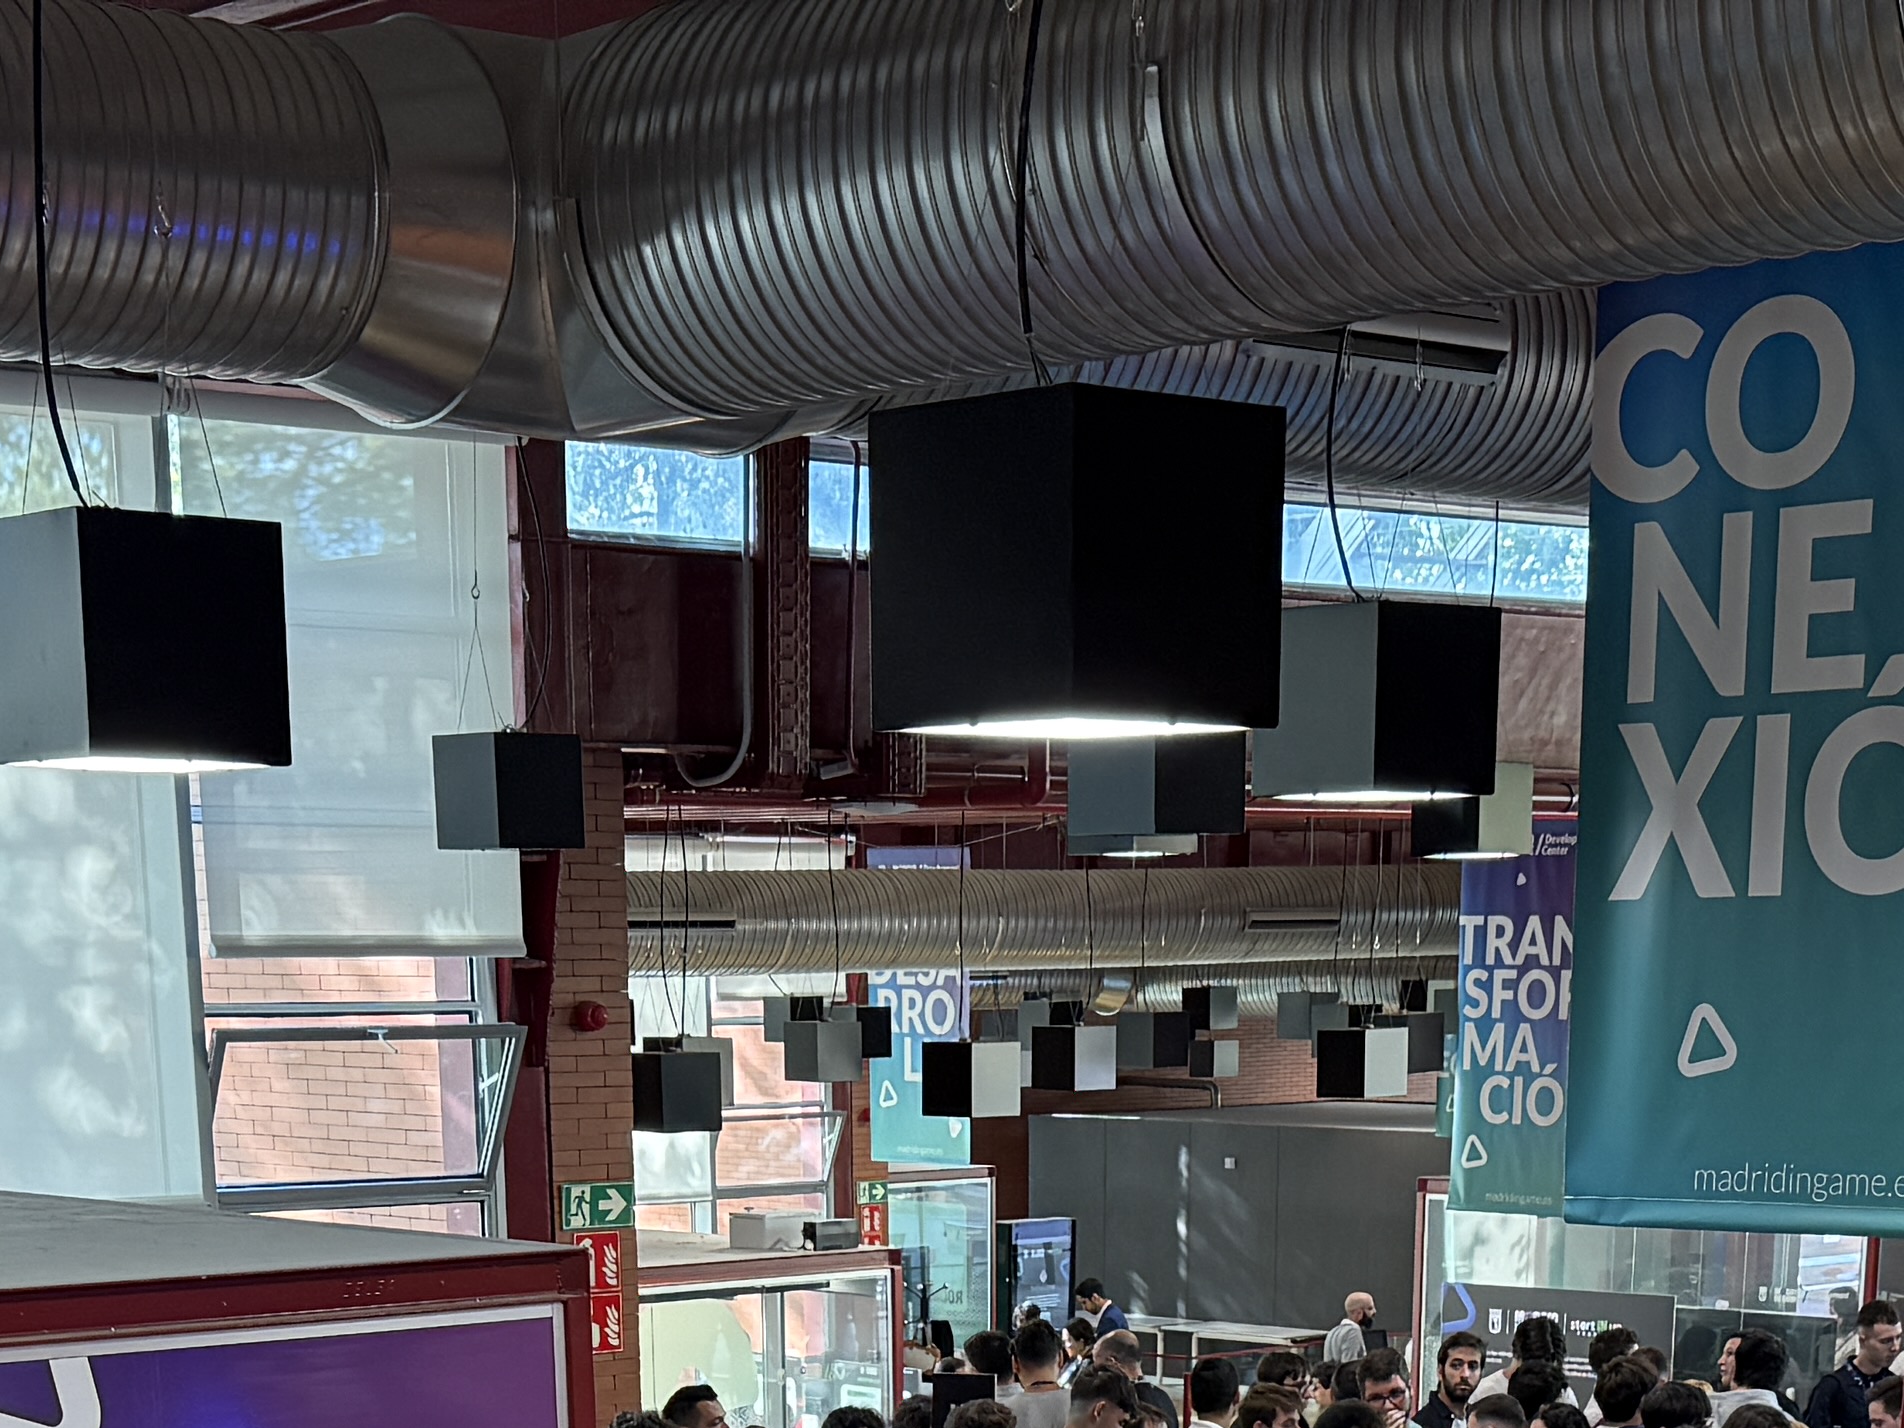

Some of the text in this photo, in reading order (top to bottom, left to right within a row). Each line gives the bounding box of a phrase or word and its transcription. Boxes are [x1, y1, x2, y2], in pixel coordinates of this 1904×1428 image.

[1590, 293, 1855, 504] CO
[1627, 498, 1874, 703] NE
[1463, 1021, 1540, 1073] MA
[1480, 1061, 1564, 1127] CIÓ
